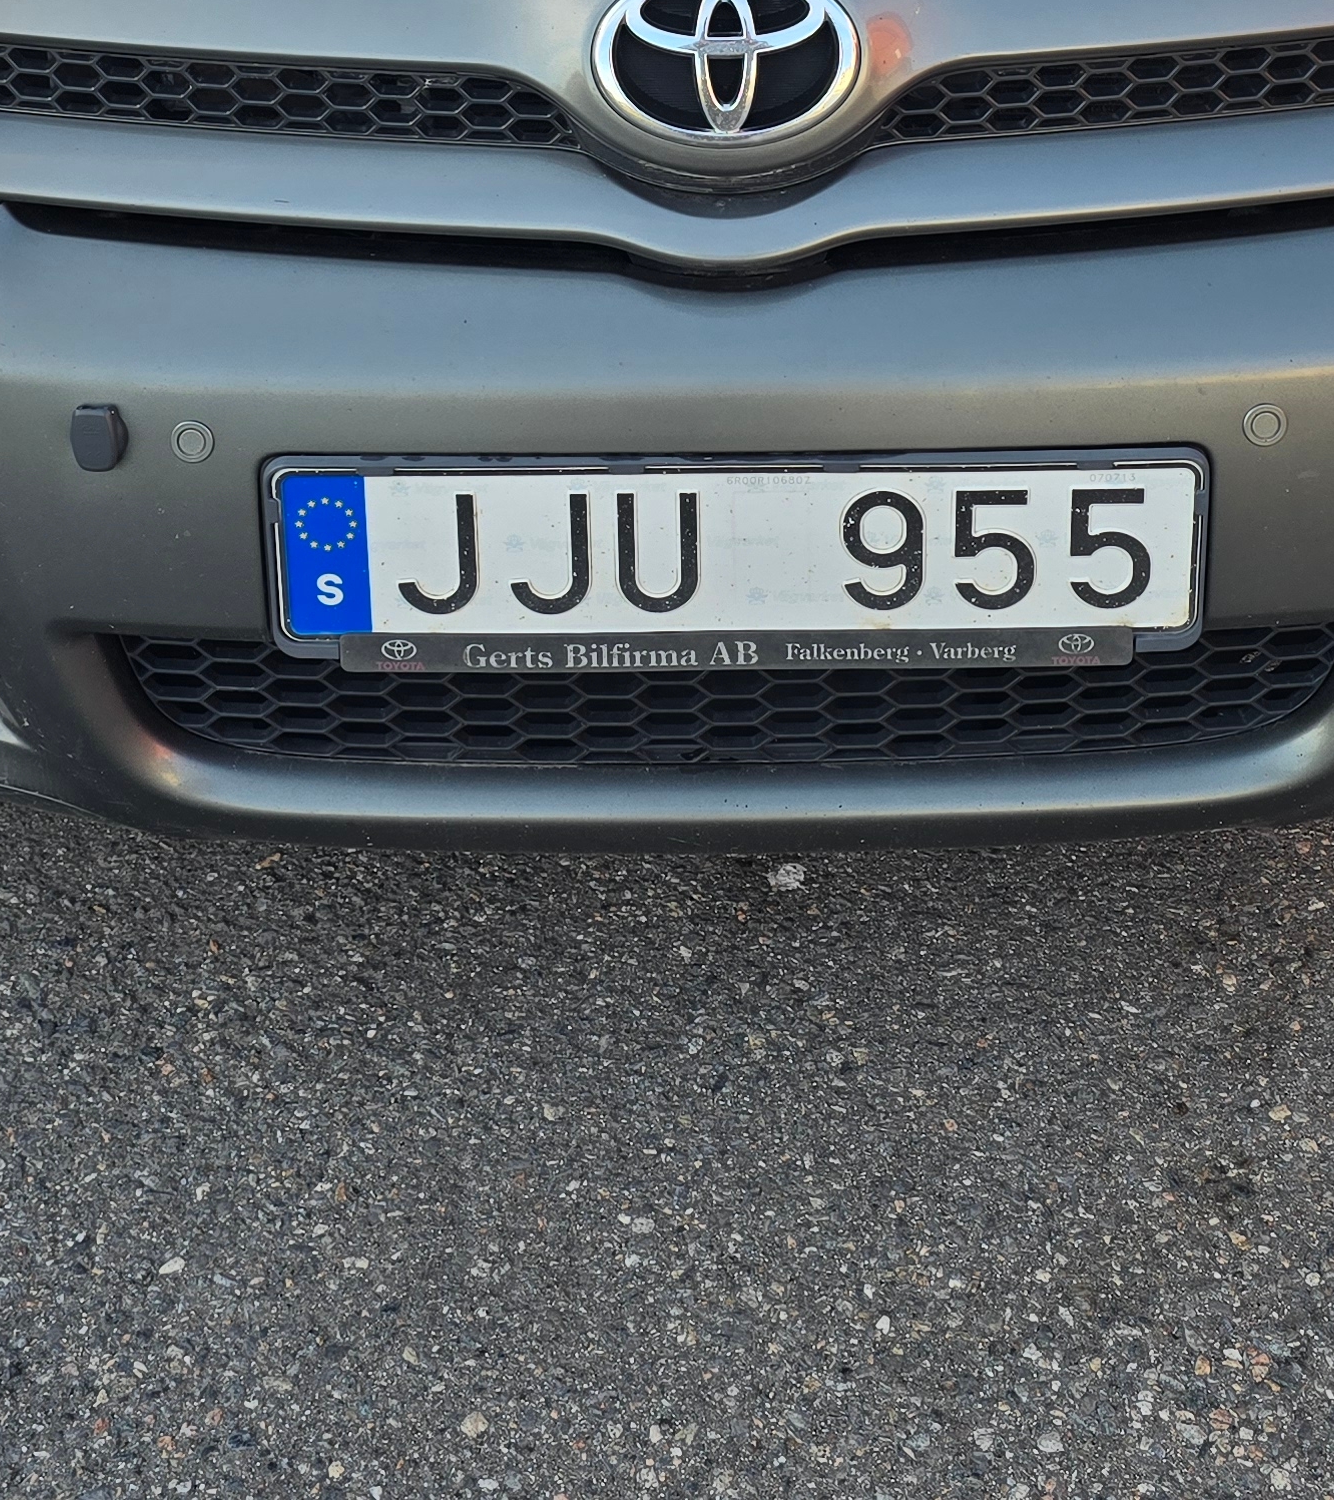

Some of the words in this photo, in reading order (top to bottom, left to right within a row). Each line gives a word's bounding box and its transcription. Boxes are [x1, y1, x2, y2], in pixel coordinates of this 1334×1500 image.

[1089, 472, 1136, 482] 070713
[398, 492, 698, 614] JJU
[842, 488, 1151, 610] 955
[316, 573, 344, 606] S
[463, 643, 553, 669] Gerts
[563, 643, 698, 668] Bilfirma
[709, 640, 759, 665] AB
[785, 642, 909, 663] Falkenberg
[929, 642, 1016, 662] Varberg
[1051, 656, 1101, 665] TOYOTA
[376, 661, 425, 671] TOYOTA
